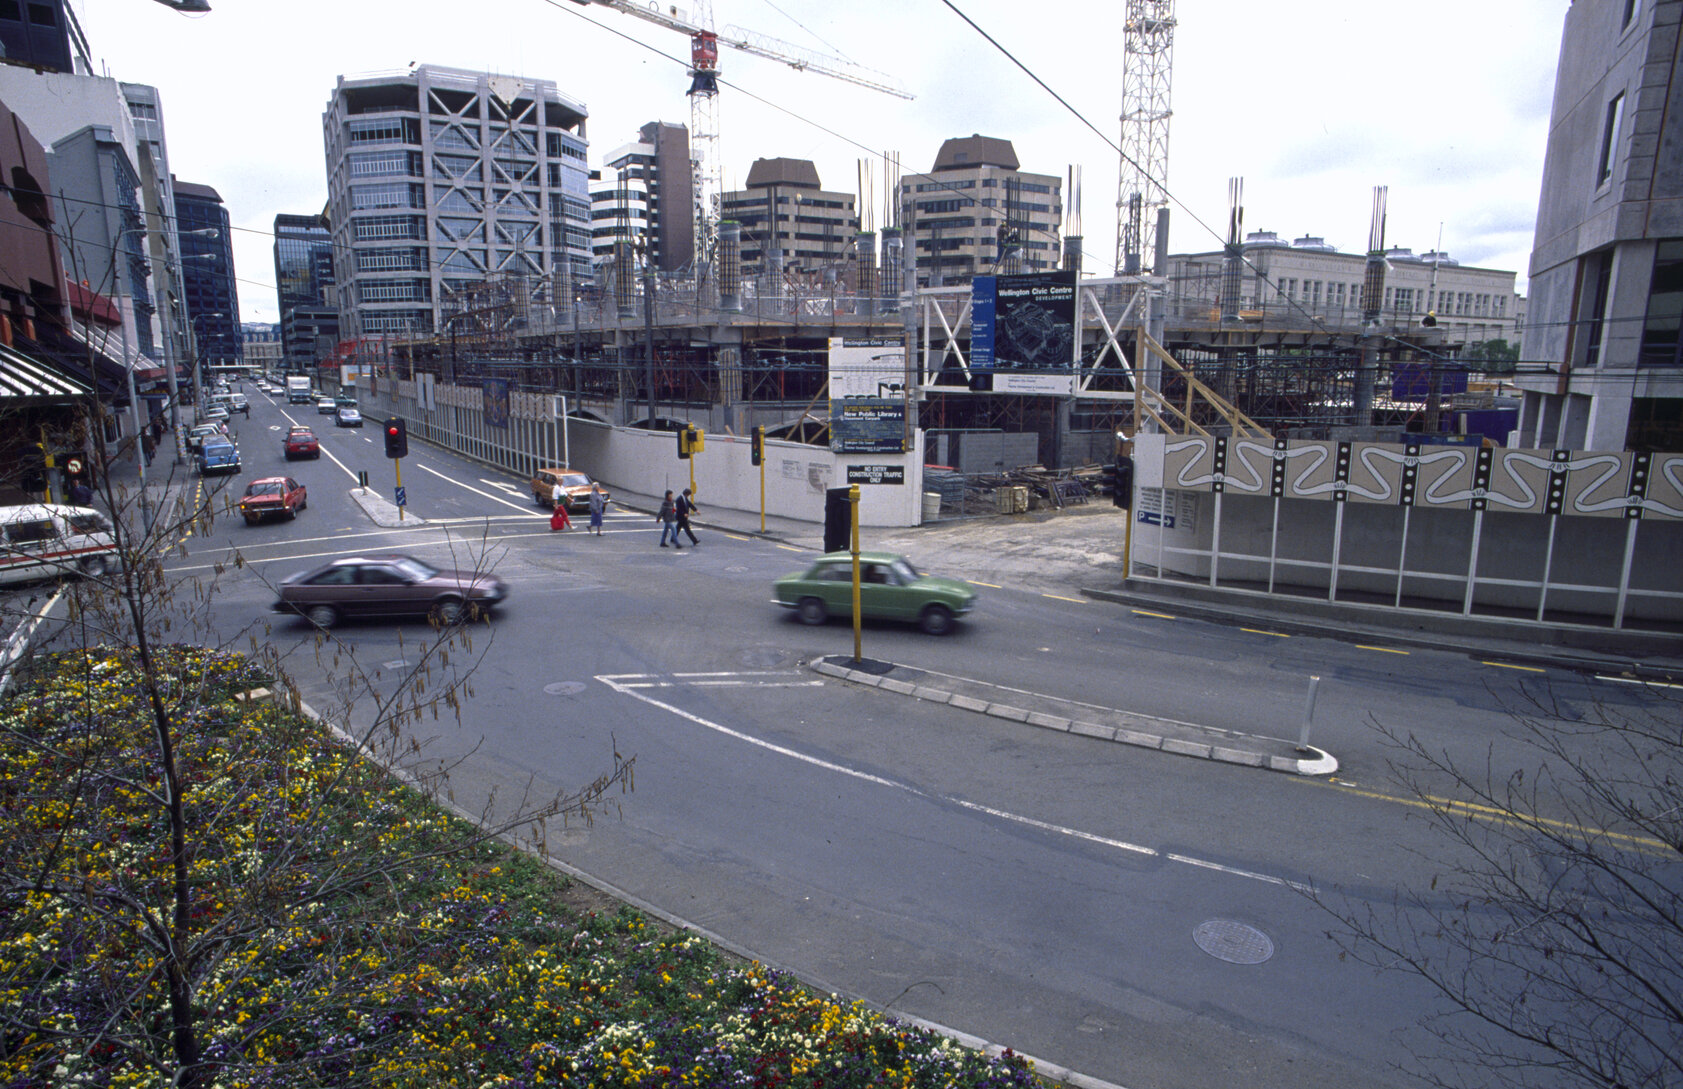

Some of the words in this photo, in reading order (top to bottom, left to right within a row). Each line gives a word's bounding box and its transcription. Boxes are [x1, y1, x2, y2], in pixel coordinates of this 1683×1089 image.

[998, 289, 1030, 297] Wellington
[1031, 287, 1048, 295] Civic
[1050, 286, 1073, 294] Centre
[1139, 512, 1145, 520] P
